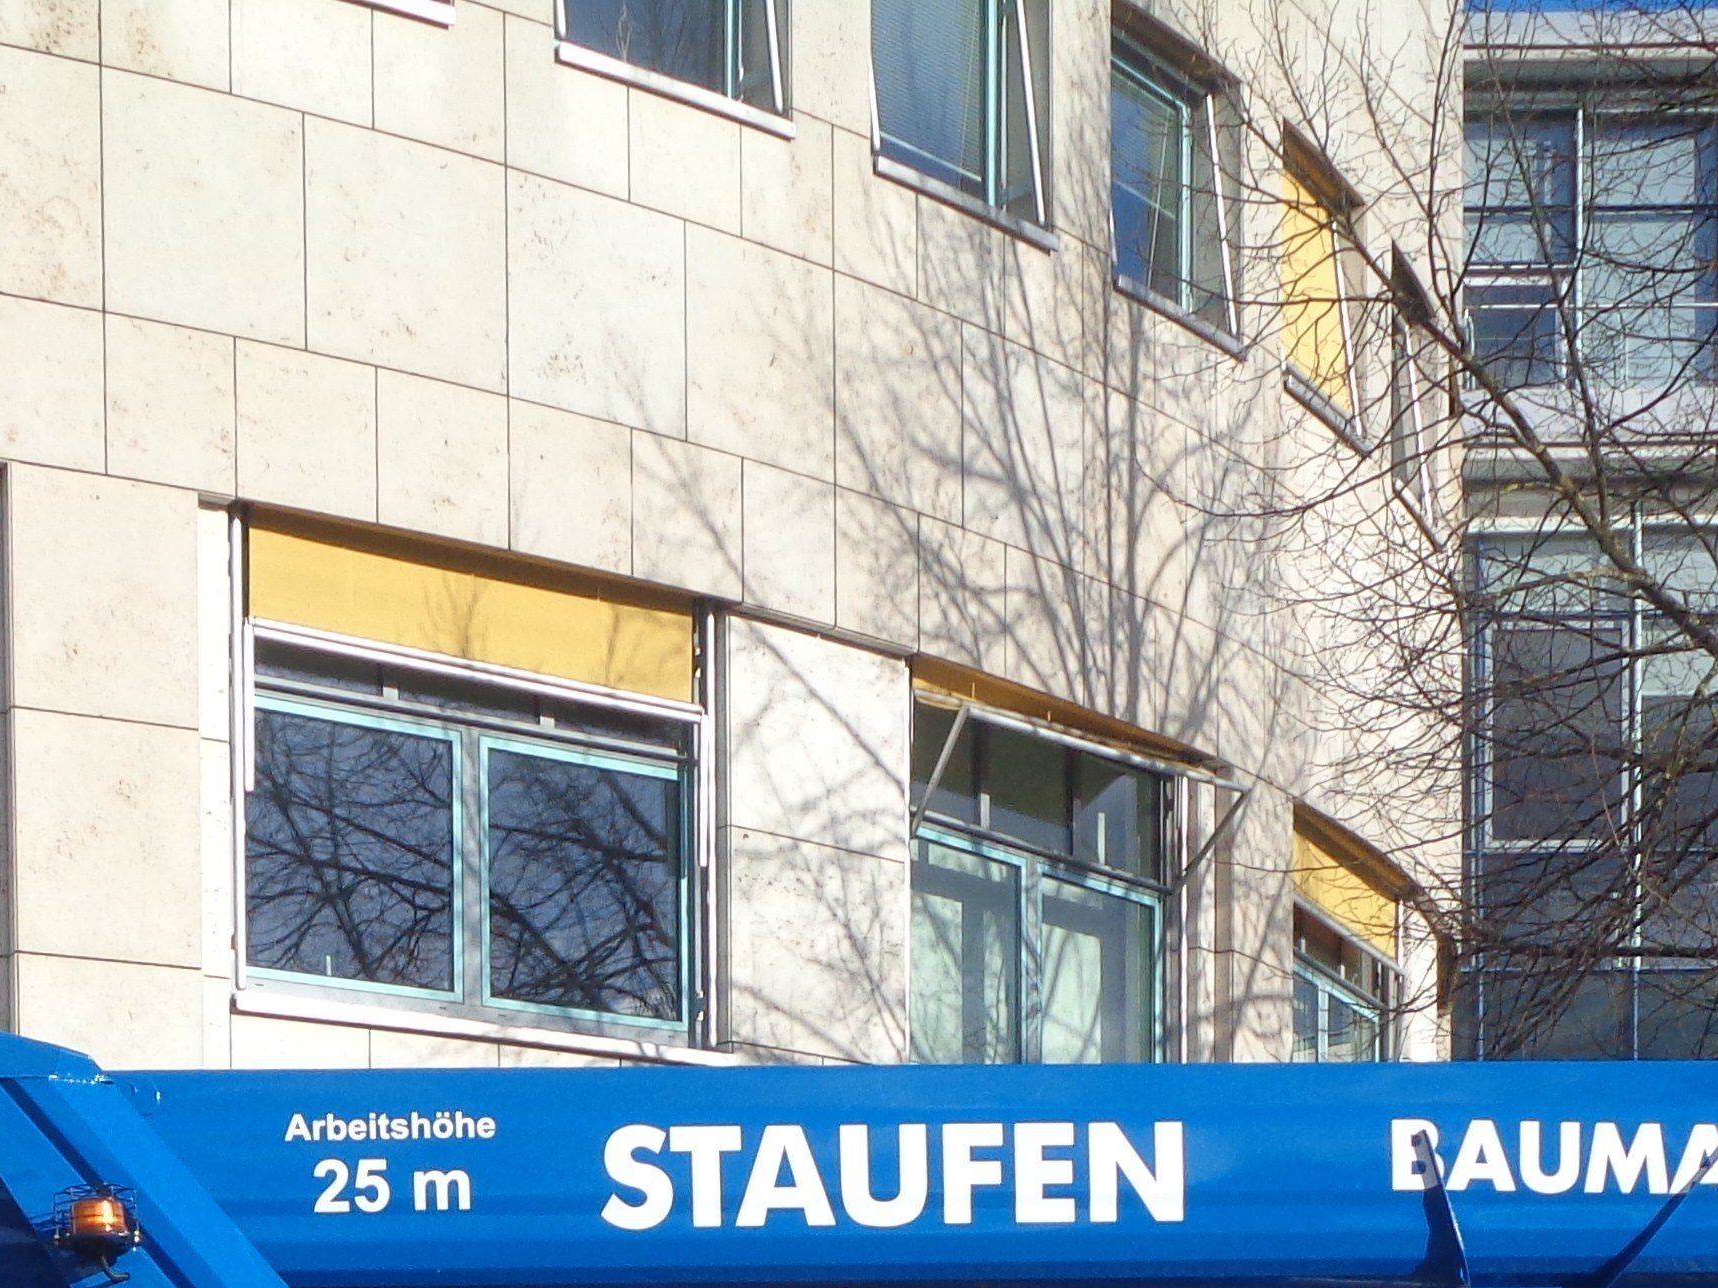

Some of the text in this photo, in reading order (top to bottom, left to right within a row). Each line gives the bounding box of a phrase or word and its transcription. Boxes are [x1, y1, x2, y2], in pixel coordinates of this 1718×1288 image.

[284, 1111, 497, 1142] Arbeitshöhe
[313, 1158, 471, 1213] 25 m
[600, 1120, 1186, 1231] STAUFEN
